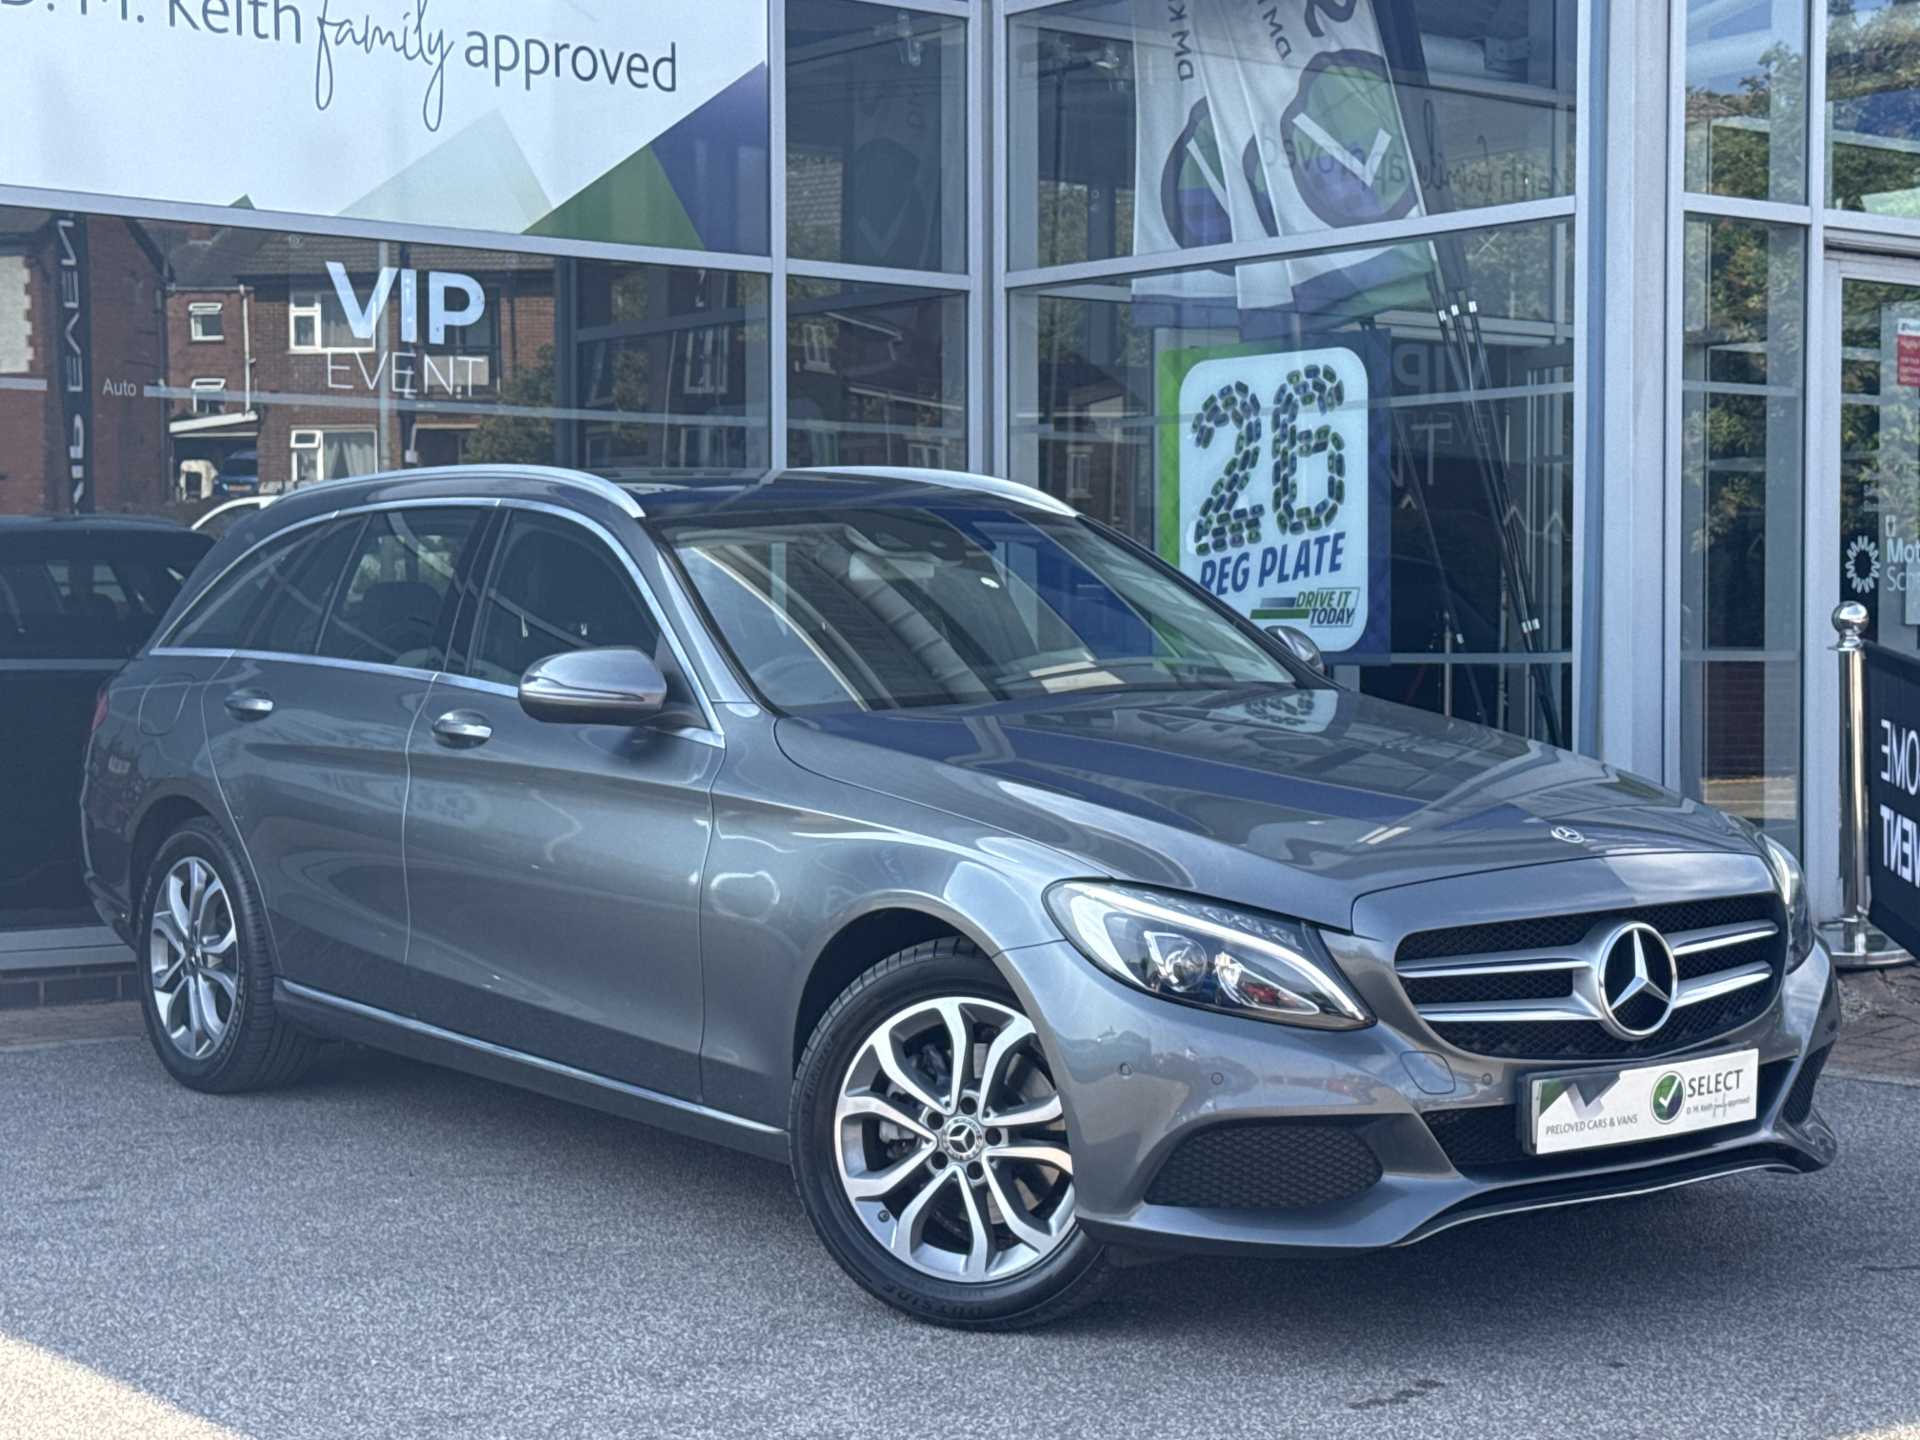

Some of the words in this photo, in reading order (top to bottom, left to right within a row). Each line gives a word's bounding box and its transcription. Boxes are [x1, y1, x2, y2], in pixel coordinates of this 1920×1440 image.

[464, 30, 677, 93] approved
[325, 261, 486, 345] VIP
[102, 378, 138, 398] Auto
[327, 349, 486, 398] EVENT
[1191, 364, 1346, 557] 26
[1200, 552, 1250, 599] REG
[1258, 531, 1347, 588] PLATE
[1295, 592, 1335, 609] DRIVE
[1336, 590, 1352, 607] IT
[1310, 607, 1356, 625] TODAY
[1687, 1069, 1744, 1098] SELECT
[1545, 1120, 1586, 1136] PRELOVED
[1587, 1117, 1607, 1130] CARS
[1609, 1117, 1616, 1127] &
[1617, 1113, 1638, 1125] VANS
